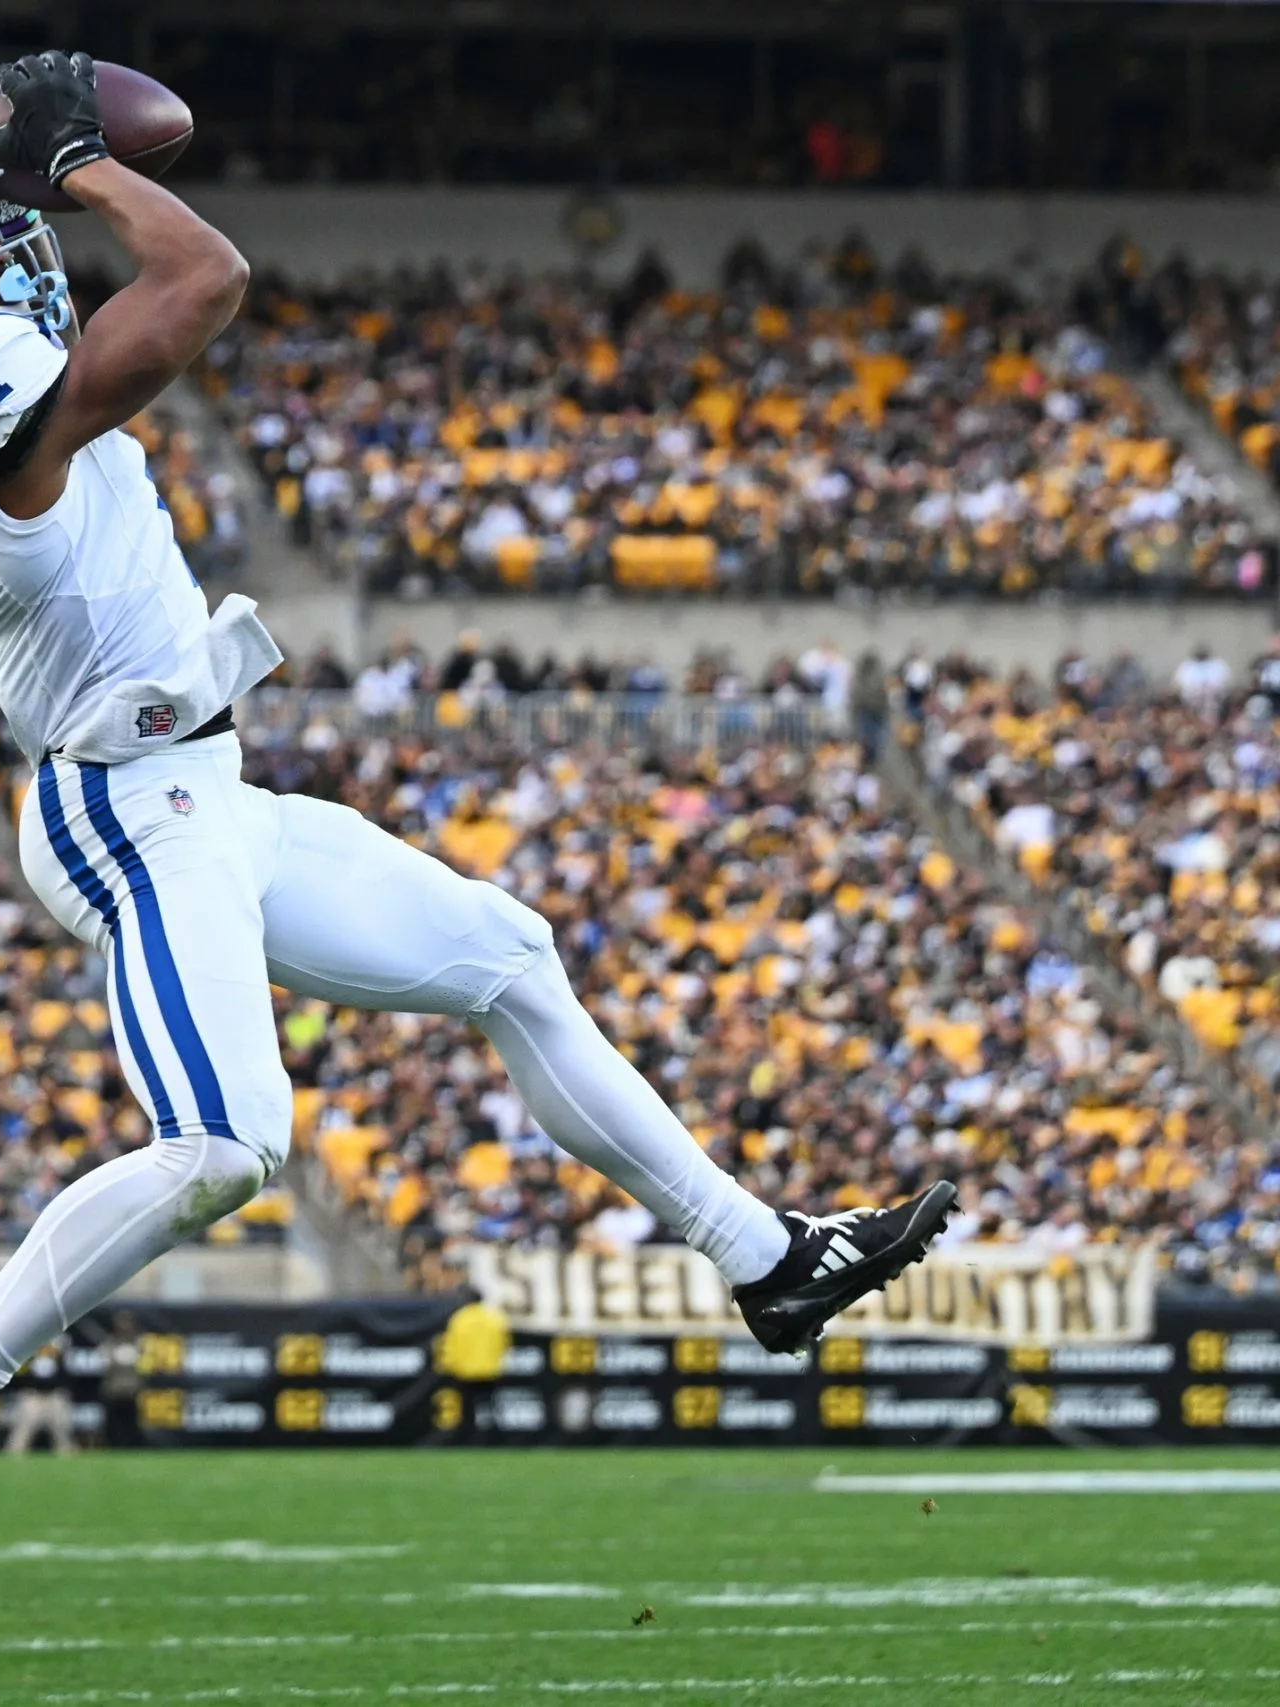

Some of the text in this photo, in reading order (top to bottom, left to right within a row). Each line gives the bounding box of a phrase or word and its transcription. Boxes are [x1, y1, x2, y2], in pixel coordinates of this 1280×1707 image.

[153, 708, 171, 733] NFL
[499, 1252, 1130, 1336] STEEL OUNTRY
